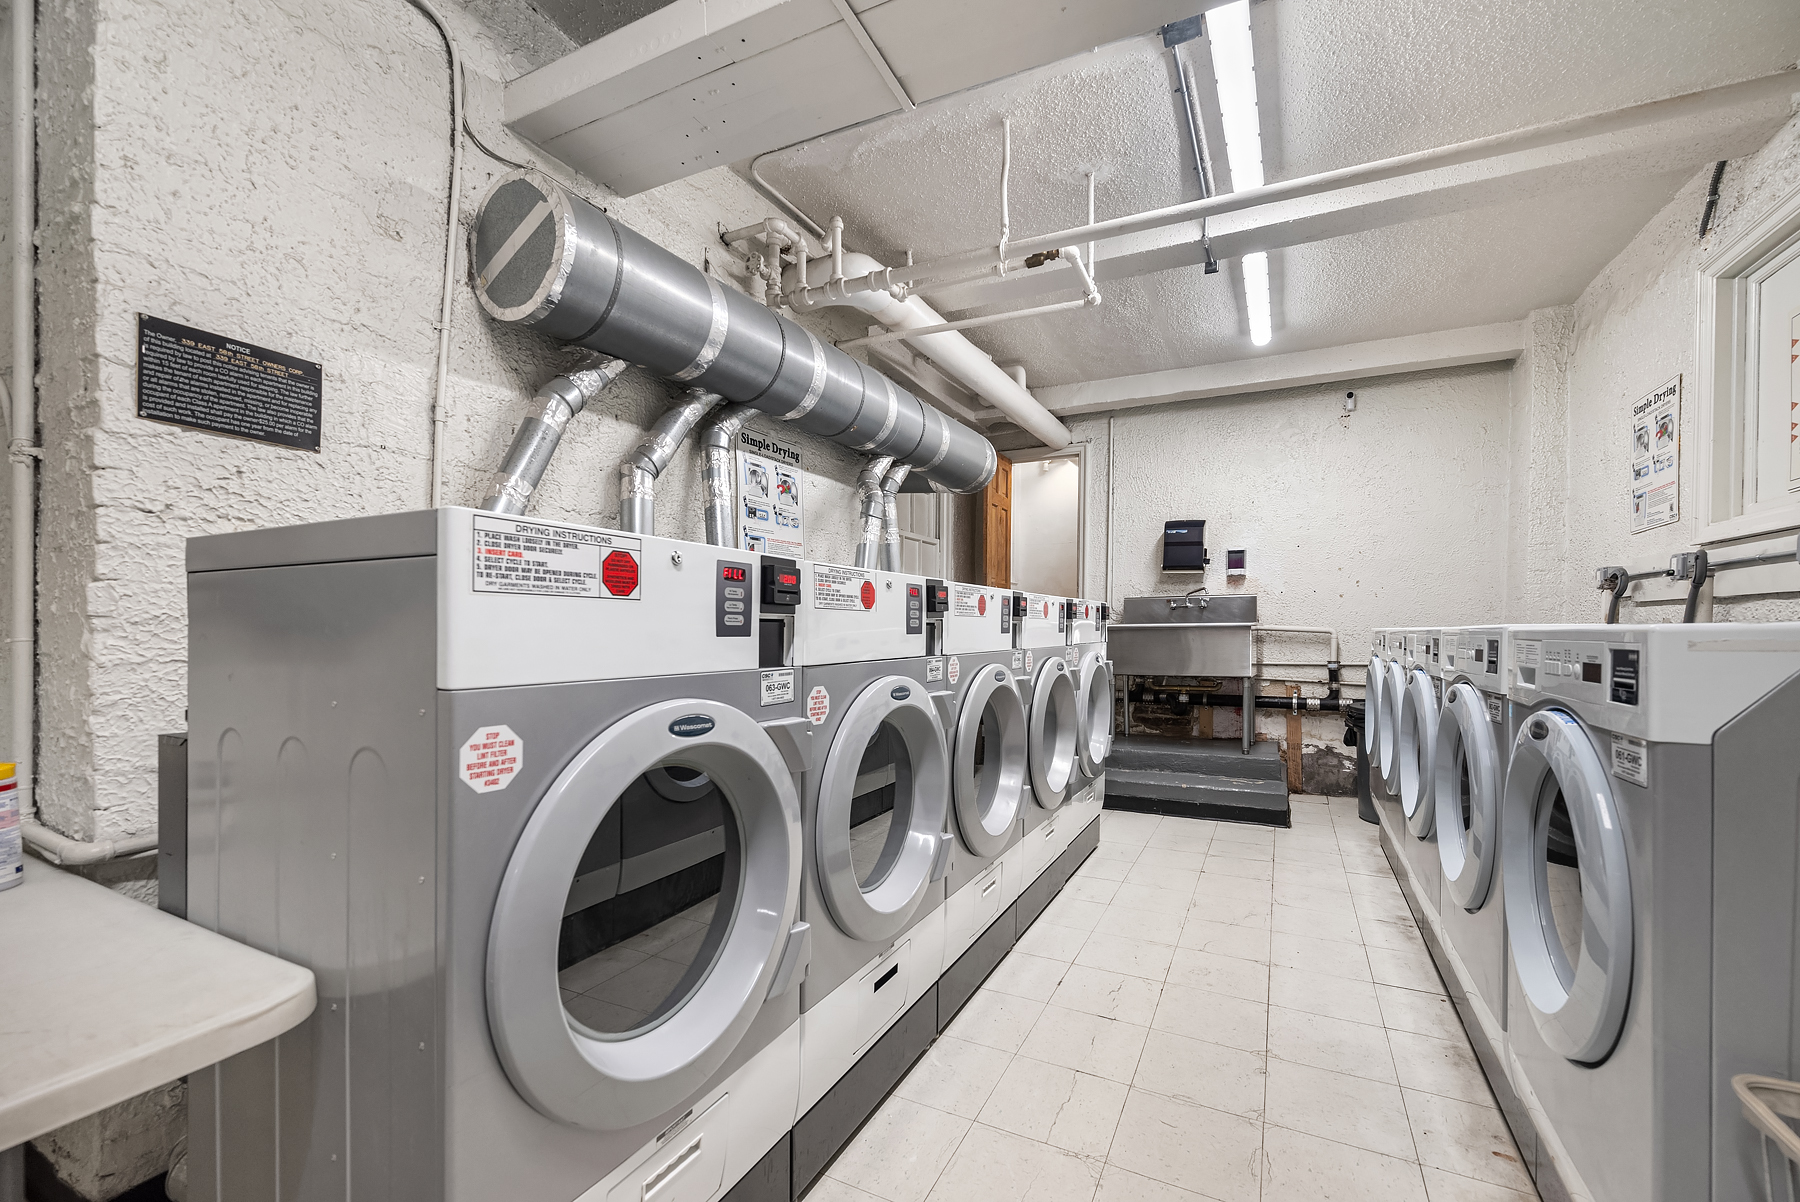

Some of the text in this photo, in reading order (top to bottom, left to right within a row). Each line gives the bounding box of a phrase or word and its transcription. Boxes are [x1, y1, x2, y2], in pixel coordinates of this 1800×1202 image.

[162, 340, 183, 351] building
[185, 346, 204, 356] located
[230, 358, 247, 367] EAST
[266, 367, 288, 377] STREET
[181, 338, 194, 346] 339
[198, 342, 215, 352] EAST
[236, 353, 259, 363] STREET
[262, 360, 285, 370] OWNERS
[226, 342, 250, 354] NOTICE
[143, 355, 160, 363] within
[218, 373, 236, 383] lawfully
[150, 344, 173, 355] required
[239, 367, 259, 377] advising
[260, 372, 277, 380] tenants
[143, 361, 312, 406] makes tenant apartment responsible maintenance
[156, 371, 308, 412] repair alarms installed apartment replacing
[194, 361, 213, 372] provide
[263, 379, 286, 390] apartment
[300, 388, 318, 398] building
[1633, 398, 1652, 416] Simple
[1653, 384, 1676, 404] Drying
[741, 432, 770, 451] Simple
[772, 443, 799, 463] Drying
[515, 524, 611, 544] DRYING INSTRUCTIONS
[723, 567, 744, 580] FILL
[766, 682, 790, 692] 063-GWC
[477, 752, 489, 760] LINT
[482, 742, 497, 750] MUST
[467, 761, 487, 771] BEFORE
[501, 757, 516, 765] AFTER
[1615, 750, 1642, 767] 061-GWC
[469, 767, 513, 780] STARTING DRYER
